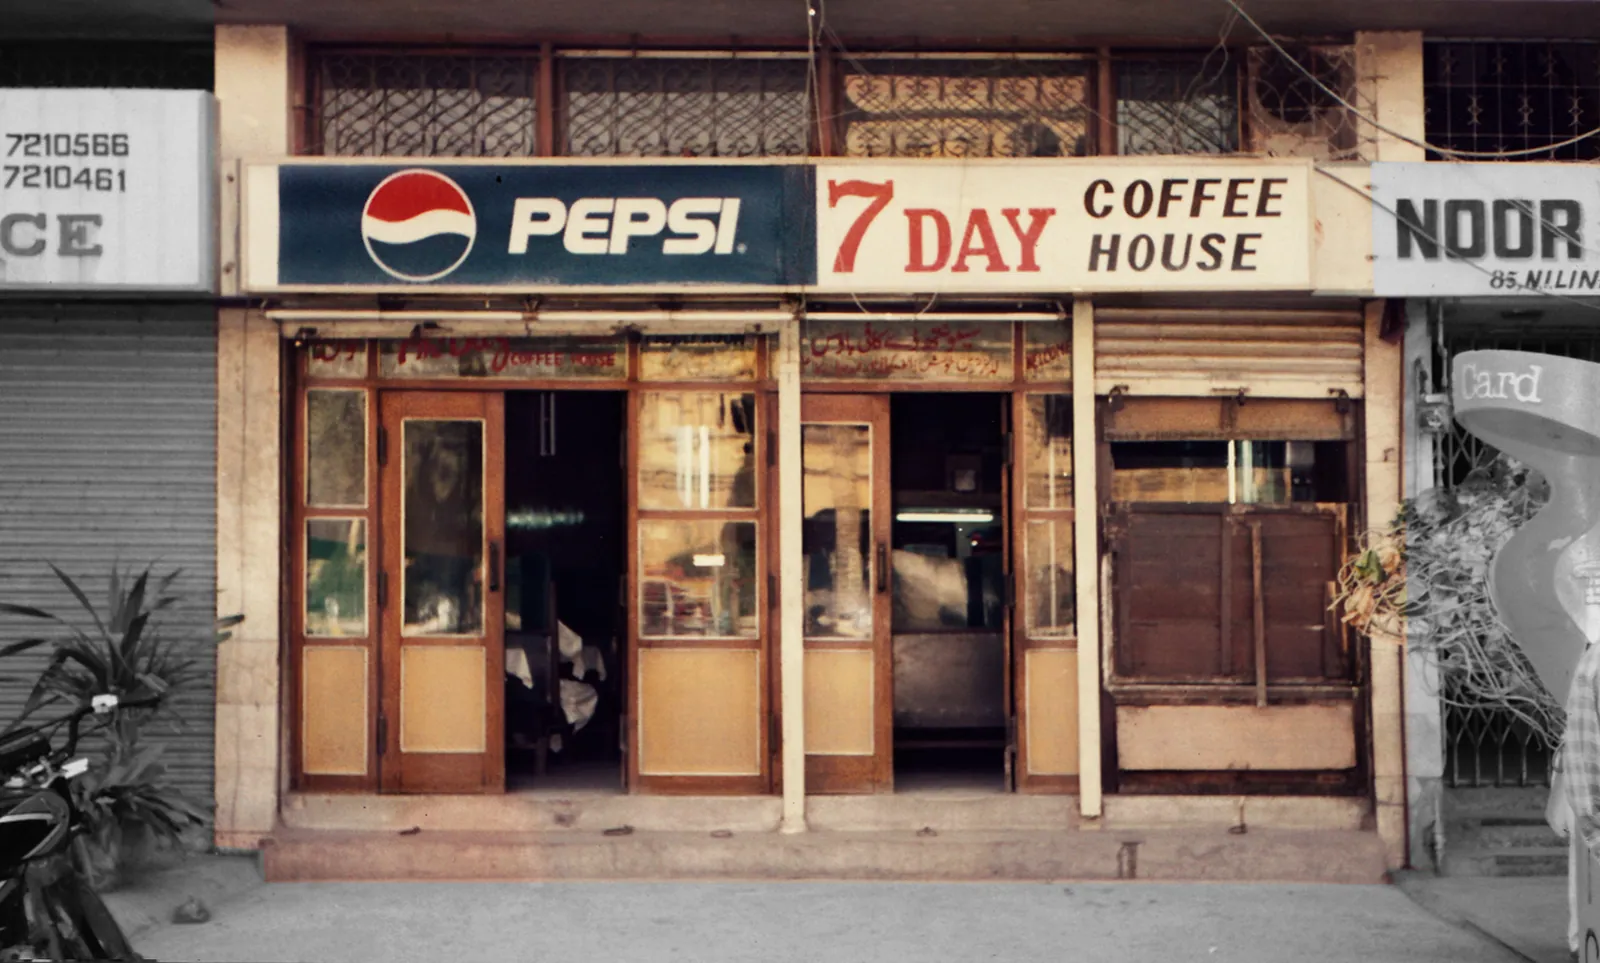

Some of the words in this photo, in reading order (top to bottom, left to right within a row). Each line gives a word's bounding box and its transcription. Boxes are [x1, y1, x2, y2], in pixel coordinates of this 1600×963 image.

[5, 133, 129, 157] 7210566
[3, 165, 126, 192] 7210461
[1083, 178, 1288, 218] COFFEE
[507, 197, 741, 255] PEPSI
[828, 179, 894, 273] 7
[903, 208, 1056, 273] DAY
[1396, 198, 1582, 259] NOOR
[1087, 232, 1263, 272] HOUSE
[1525, 269, 1600, 290] NILIN
[511, 351, 563, 367] COFFEE
[570, 351, 615, 367] HOUSE
[1461, 363, 1543, 403] Card
